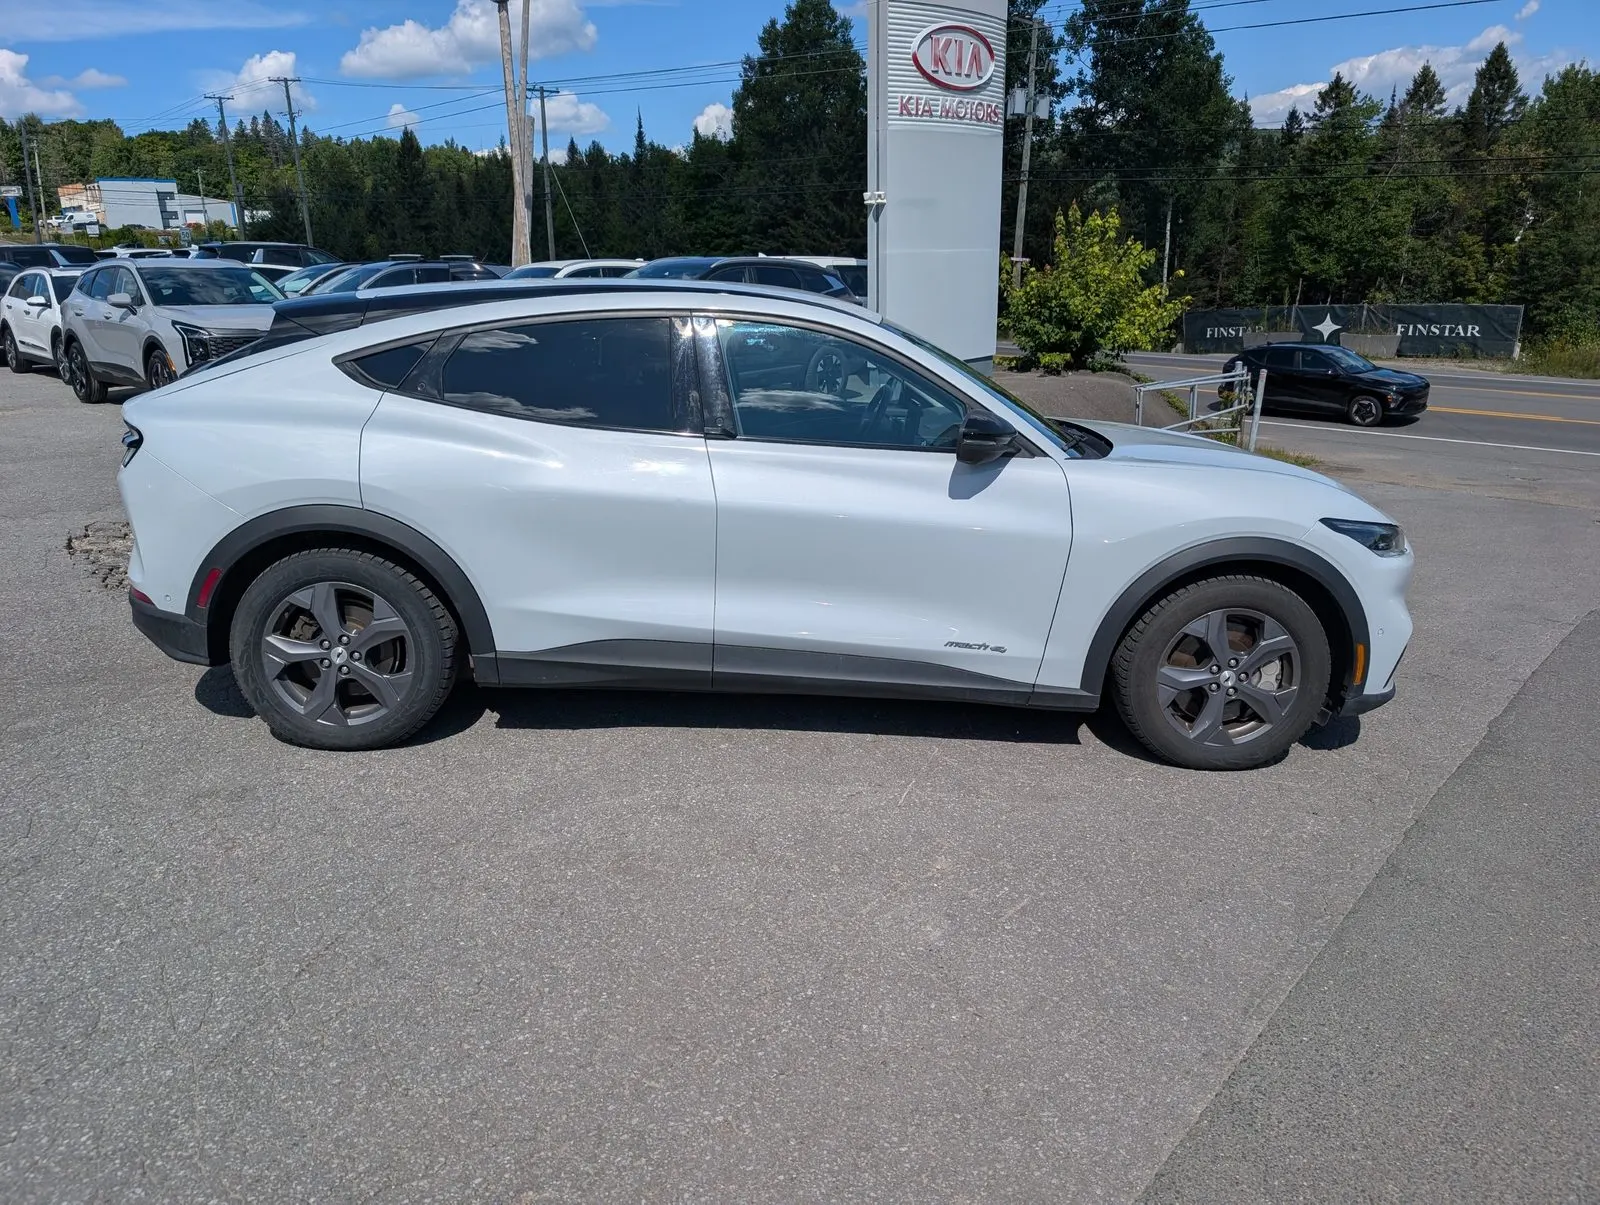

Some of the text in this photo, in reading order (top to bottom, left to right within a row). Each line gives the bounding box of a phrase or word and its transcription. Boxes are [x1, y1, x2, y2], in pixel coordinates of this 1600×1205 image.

[930, 34, 983, 79] KIA
[898, 95, 999, 123] KIA MOTORS
[181, 231, 190, 239] 50
[1396, 323, 1481, 337] FINSTAR
